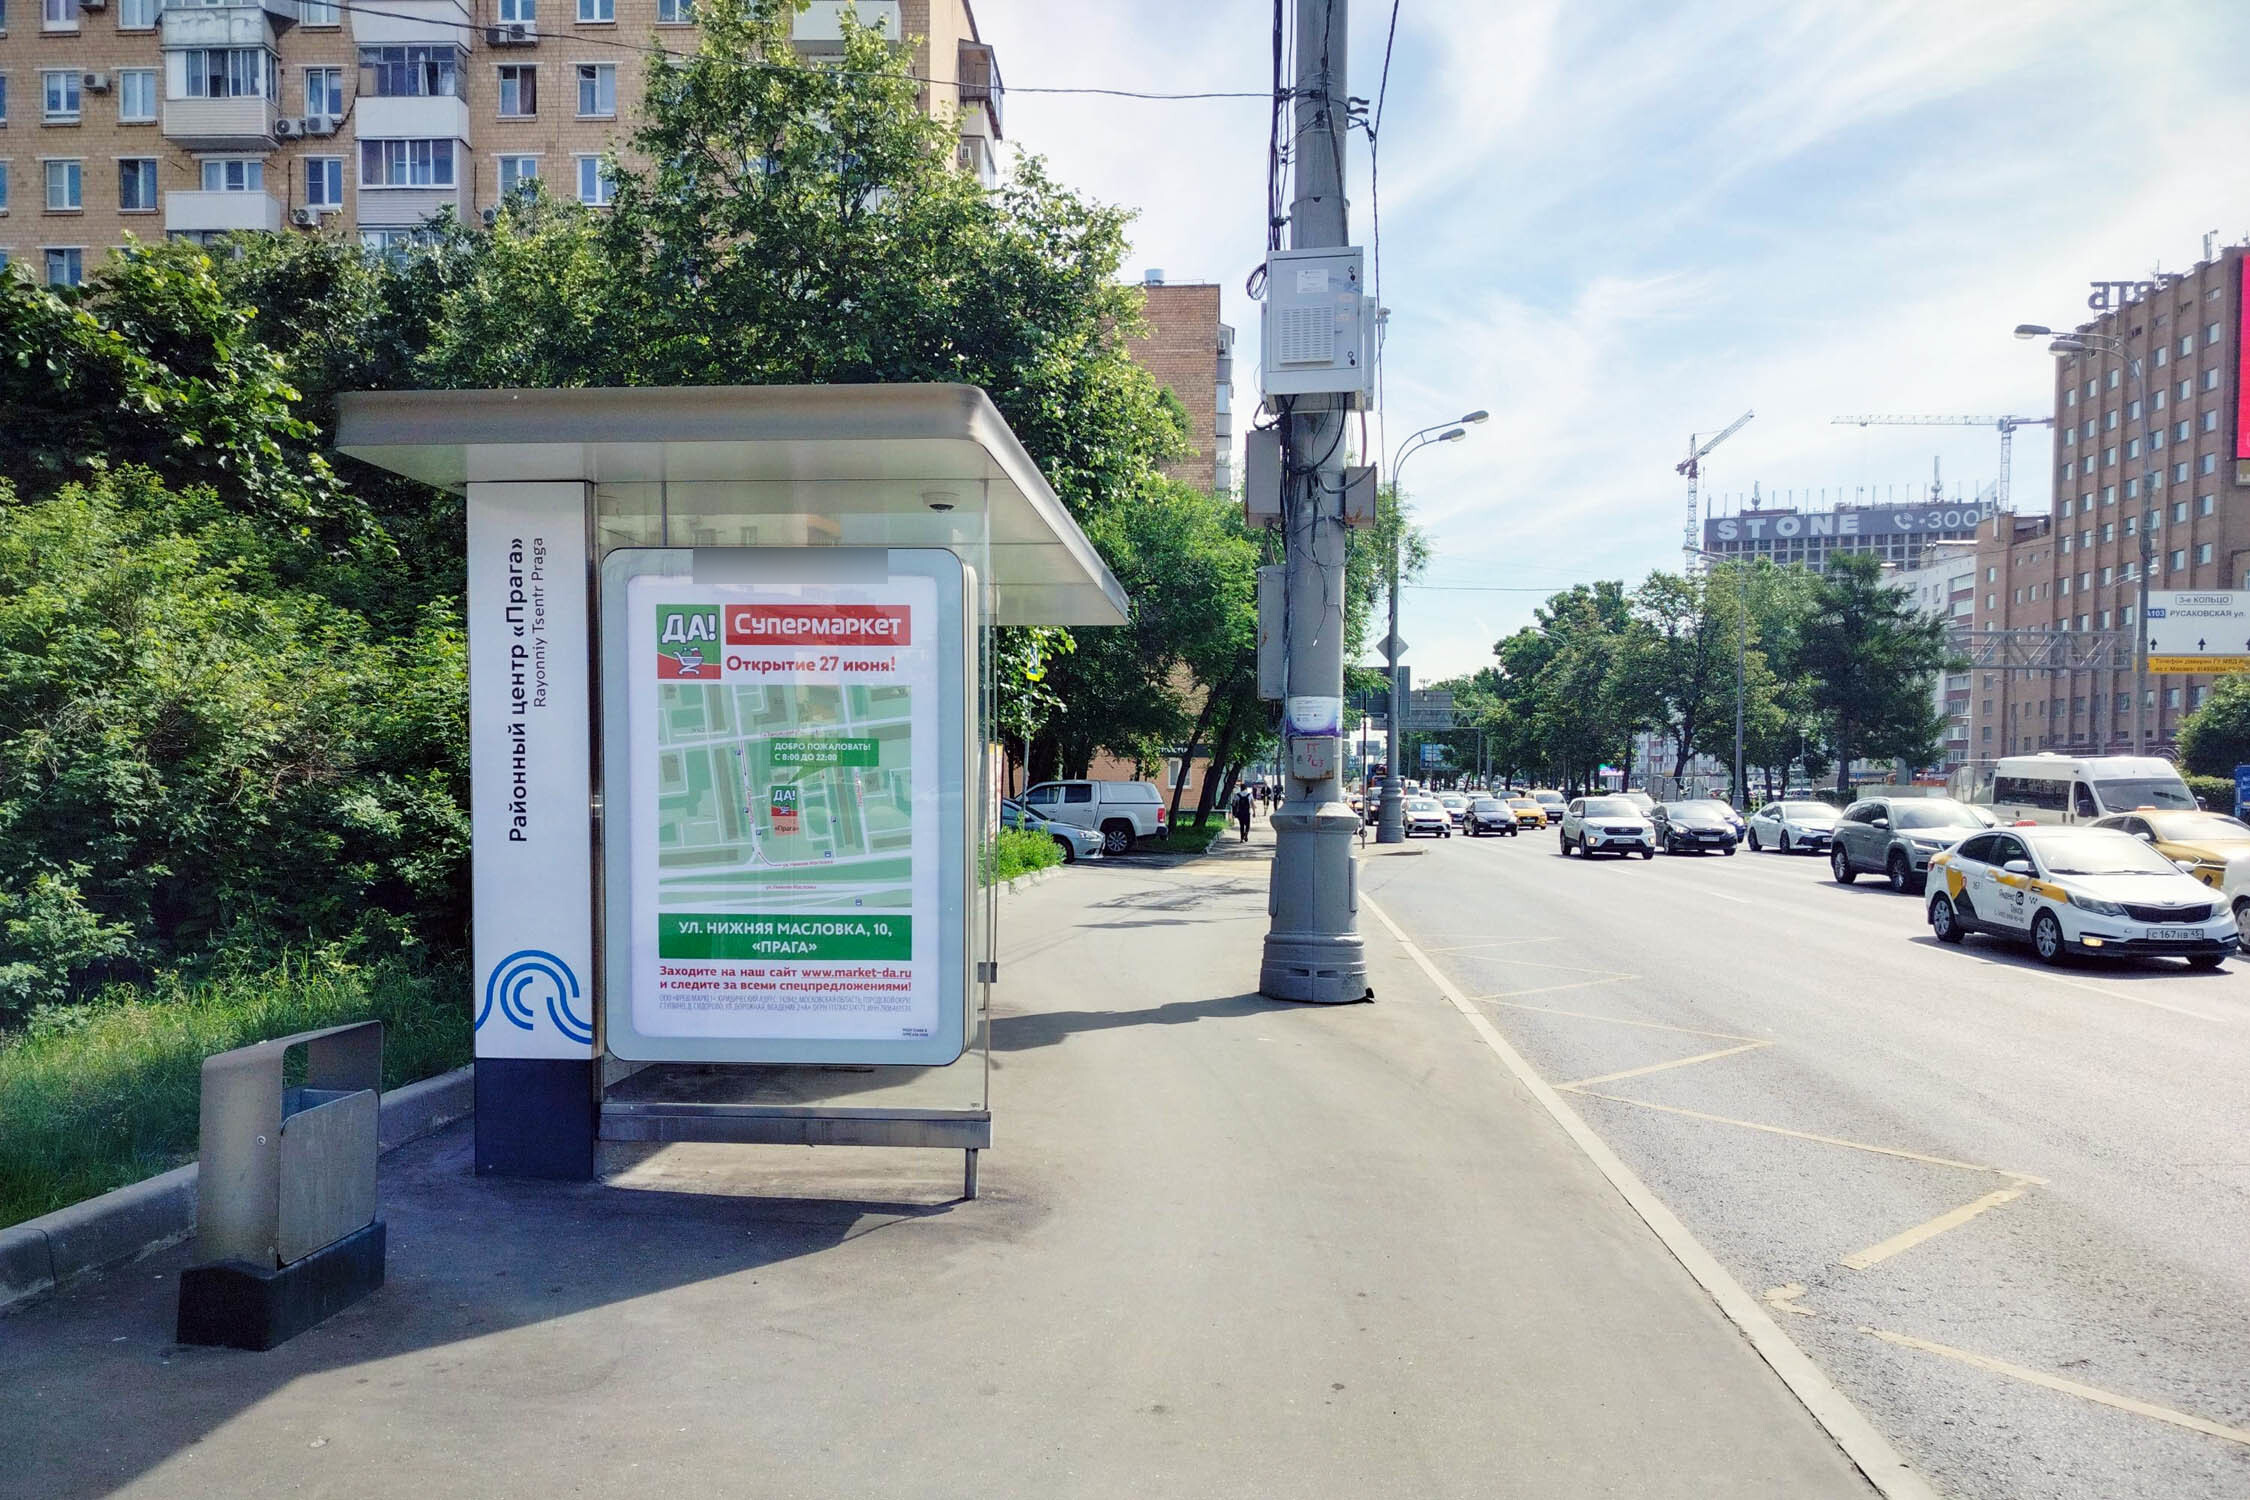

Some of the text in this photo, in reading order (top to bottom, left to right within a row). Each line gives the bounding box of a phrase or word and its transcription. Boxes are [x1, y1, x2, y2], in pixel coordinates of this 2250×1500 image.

[1717, 514, 1859, 540] STONE
[2193, 597, 2229, 605] КОЛЬЦО
[531, 537, 549, 708] Rayonniy Tsentr Praga
[661, 612, 717, 645] ДА!
[734, 612, 902, 636] Супермаркет
[726, 655, 896, 676] Открытие 27 июня!
[506, 538, 529, 842] Районный центр «Прага»
[774, 743, 871, 752] ДОБРО ПОЖАЛОВАТЬ!
[774, 753, 837, 763] С 8:00 ДО 22:00
[773, 789, 796, 801] ДА!
[678, 921, 893, 937] УЛ. НИЖНЯЯ МАСЛОВКА, 10,
[752, 940, 817, 953] «ПРАГА»
[659, 966, 912, 979] Заходите на наш сайт www.market-da.ru
[670, 981, 720, 991] следите
[723, 981, 737, 989] за
[740, 982, 776, 990] всеми
[779, 981, 912, 992] спецпредложениями!
